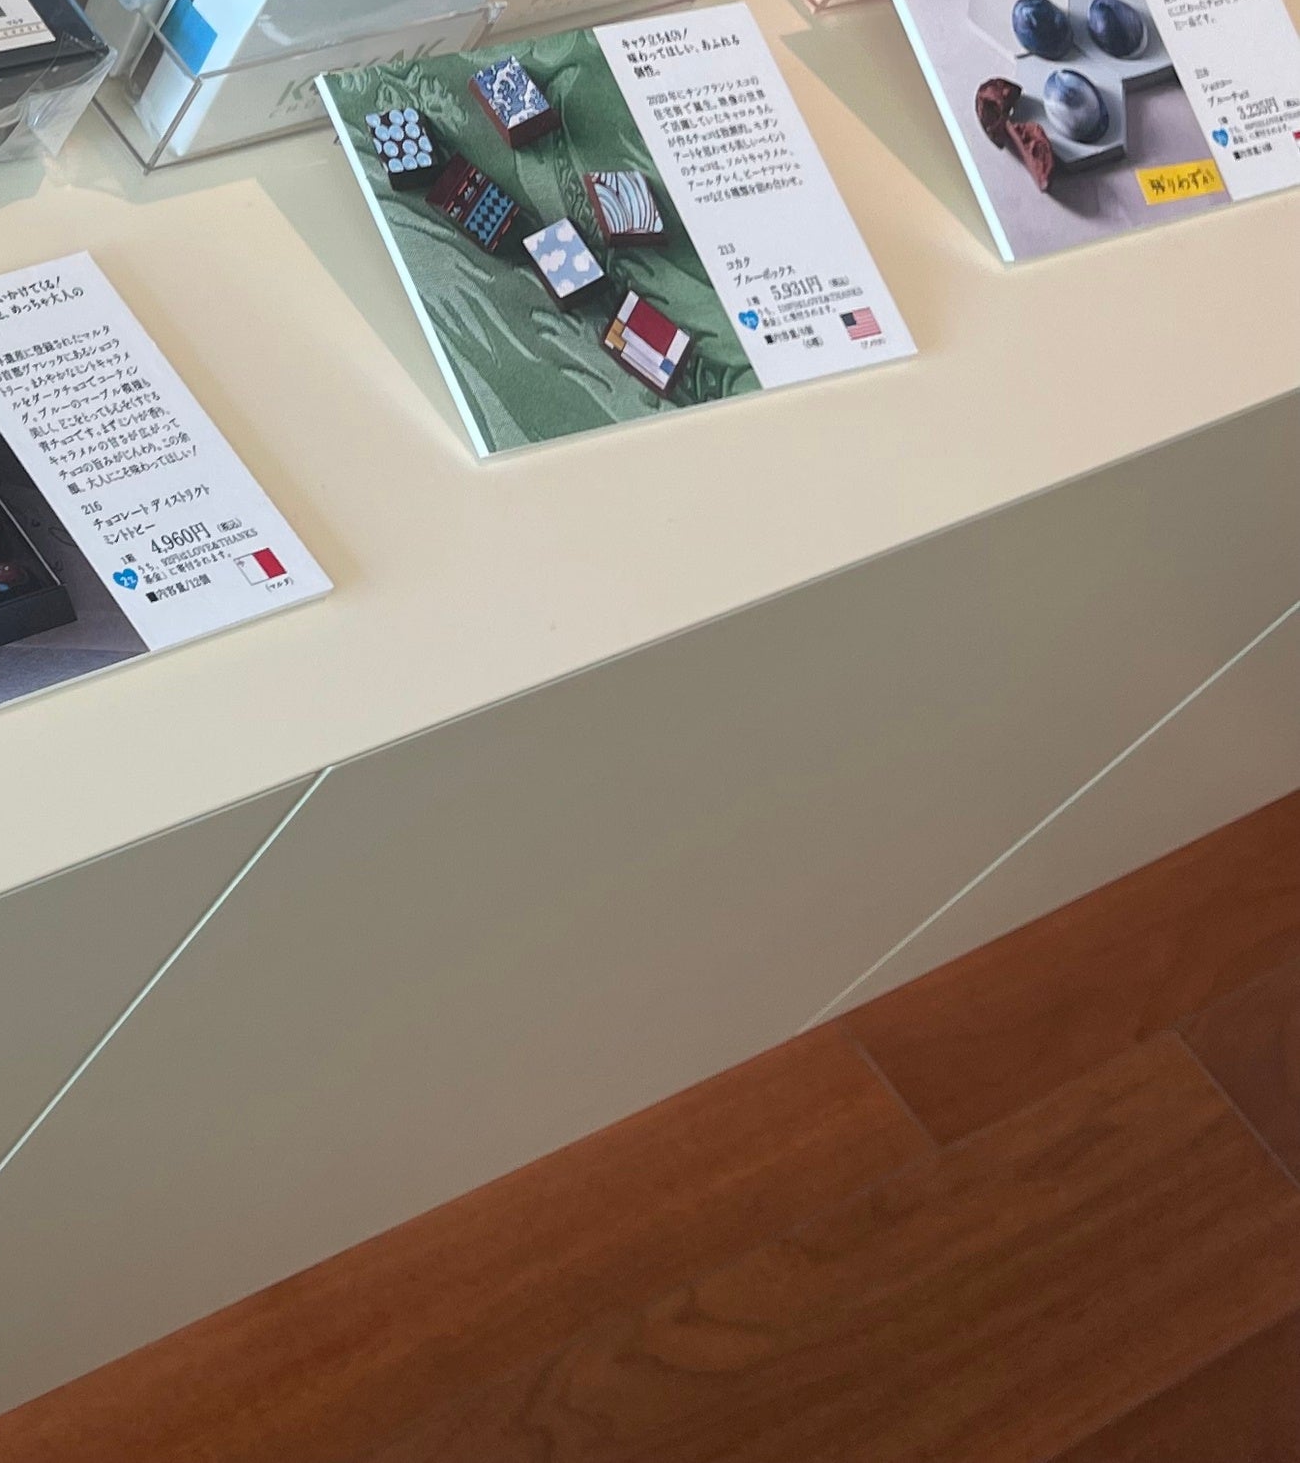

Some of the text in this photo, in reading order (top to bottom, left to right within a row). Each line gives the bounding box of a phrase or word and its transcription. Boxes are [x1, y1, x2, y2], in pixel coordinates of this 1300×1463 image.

[80, 500, 103, 516] 216
[93, 483, 210, 531] チョコレート ディストリクト
[151, 521, 212, 554] 4,960円
